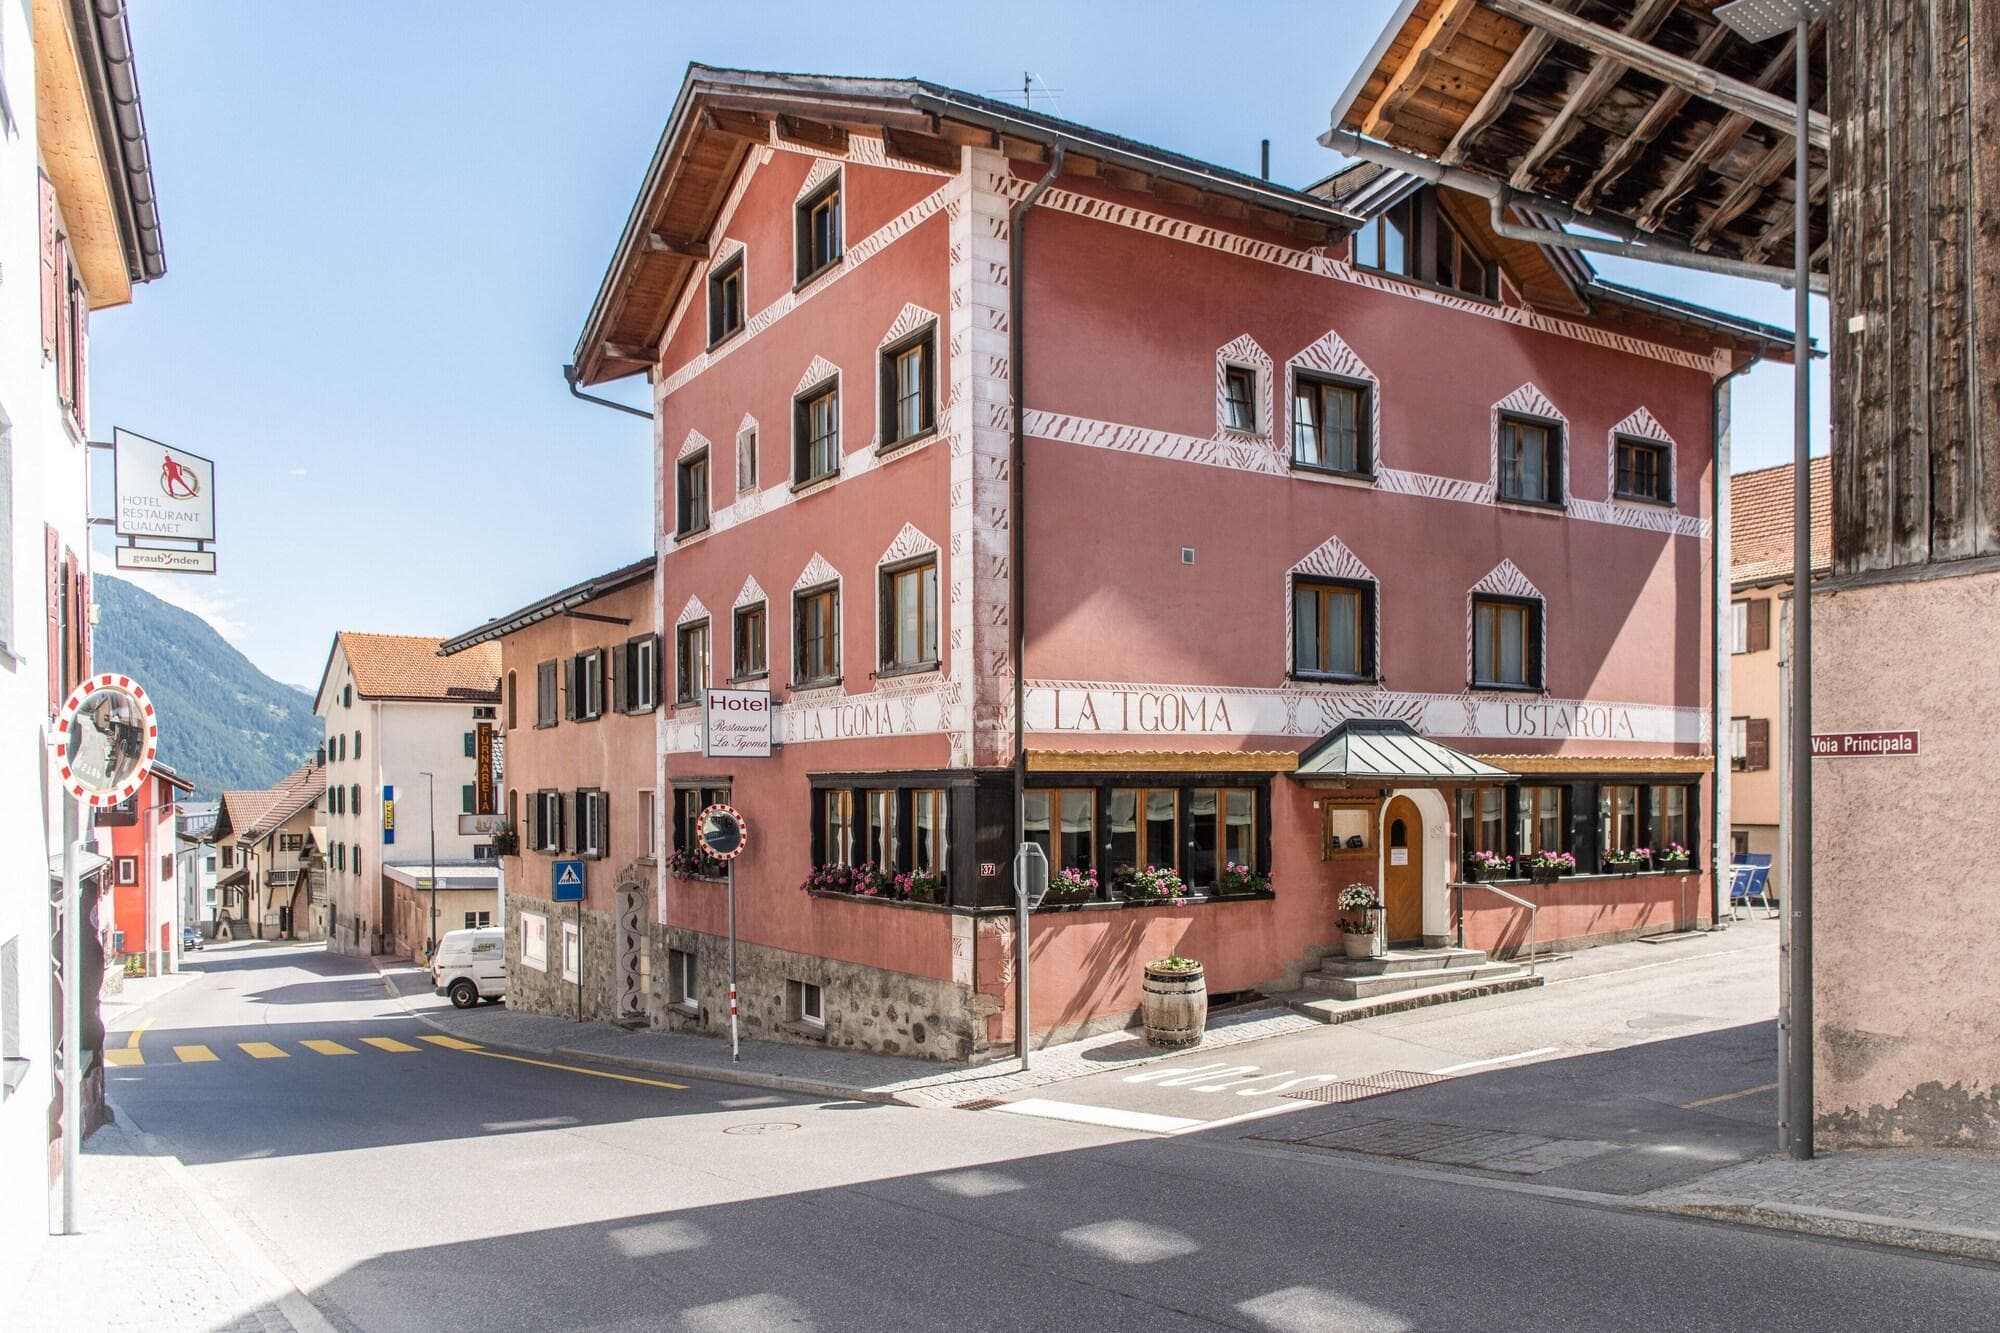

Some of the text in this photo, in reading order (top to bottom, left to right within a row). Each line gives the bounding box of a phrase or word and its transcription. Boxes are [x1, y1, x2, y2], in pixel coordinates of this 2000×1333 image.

[122, 495, 161, 507] HOTEL
[122, 507, 200, 522] RESTAURANT
[122, 520, 181, 533] CUALMET
[710, 695, 768, 711] Hotel
[1054, 689, 1233, 732] LA TGOMA
[710, 719, 768, 732] Restaurant
[803, 701, 894, 740] LA TGOMA
[1505, 704, 1634, 738] USTAROIA
[710, 734, 729, 747] La
[731, 734, 768, 751] Tgoma
[1811, 734, 1913, 755] Voia Principala
[481, 726, 490, 811] FURNAREIA
[983, 865, 993, 874] 37
